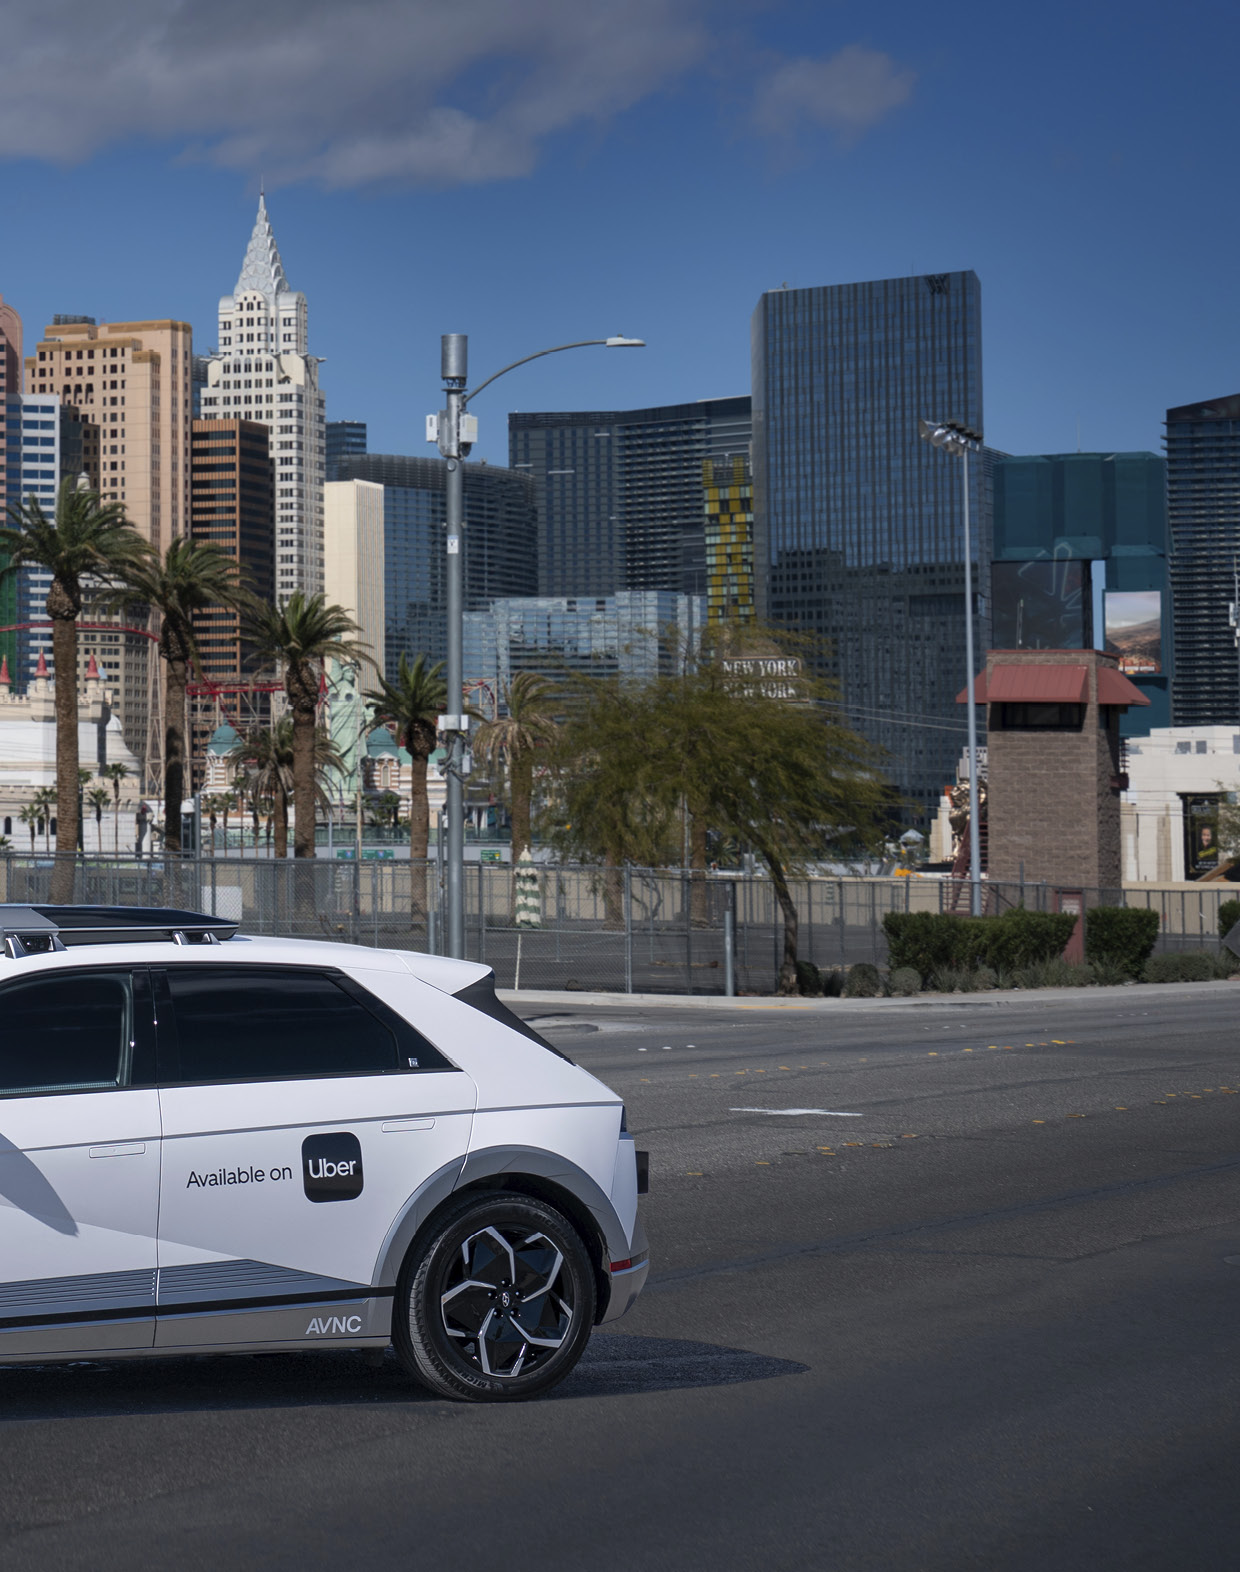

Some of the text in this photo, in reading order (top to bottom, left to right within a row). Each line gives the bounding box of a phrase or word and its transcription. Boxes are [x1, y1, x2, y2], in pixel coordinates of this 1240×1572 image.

[723, 660, 798, 677] NEW YORK
[186, 1158, 357, 1189] Available on Uber
[305, 1315, 362, 1335] AVNC
